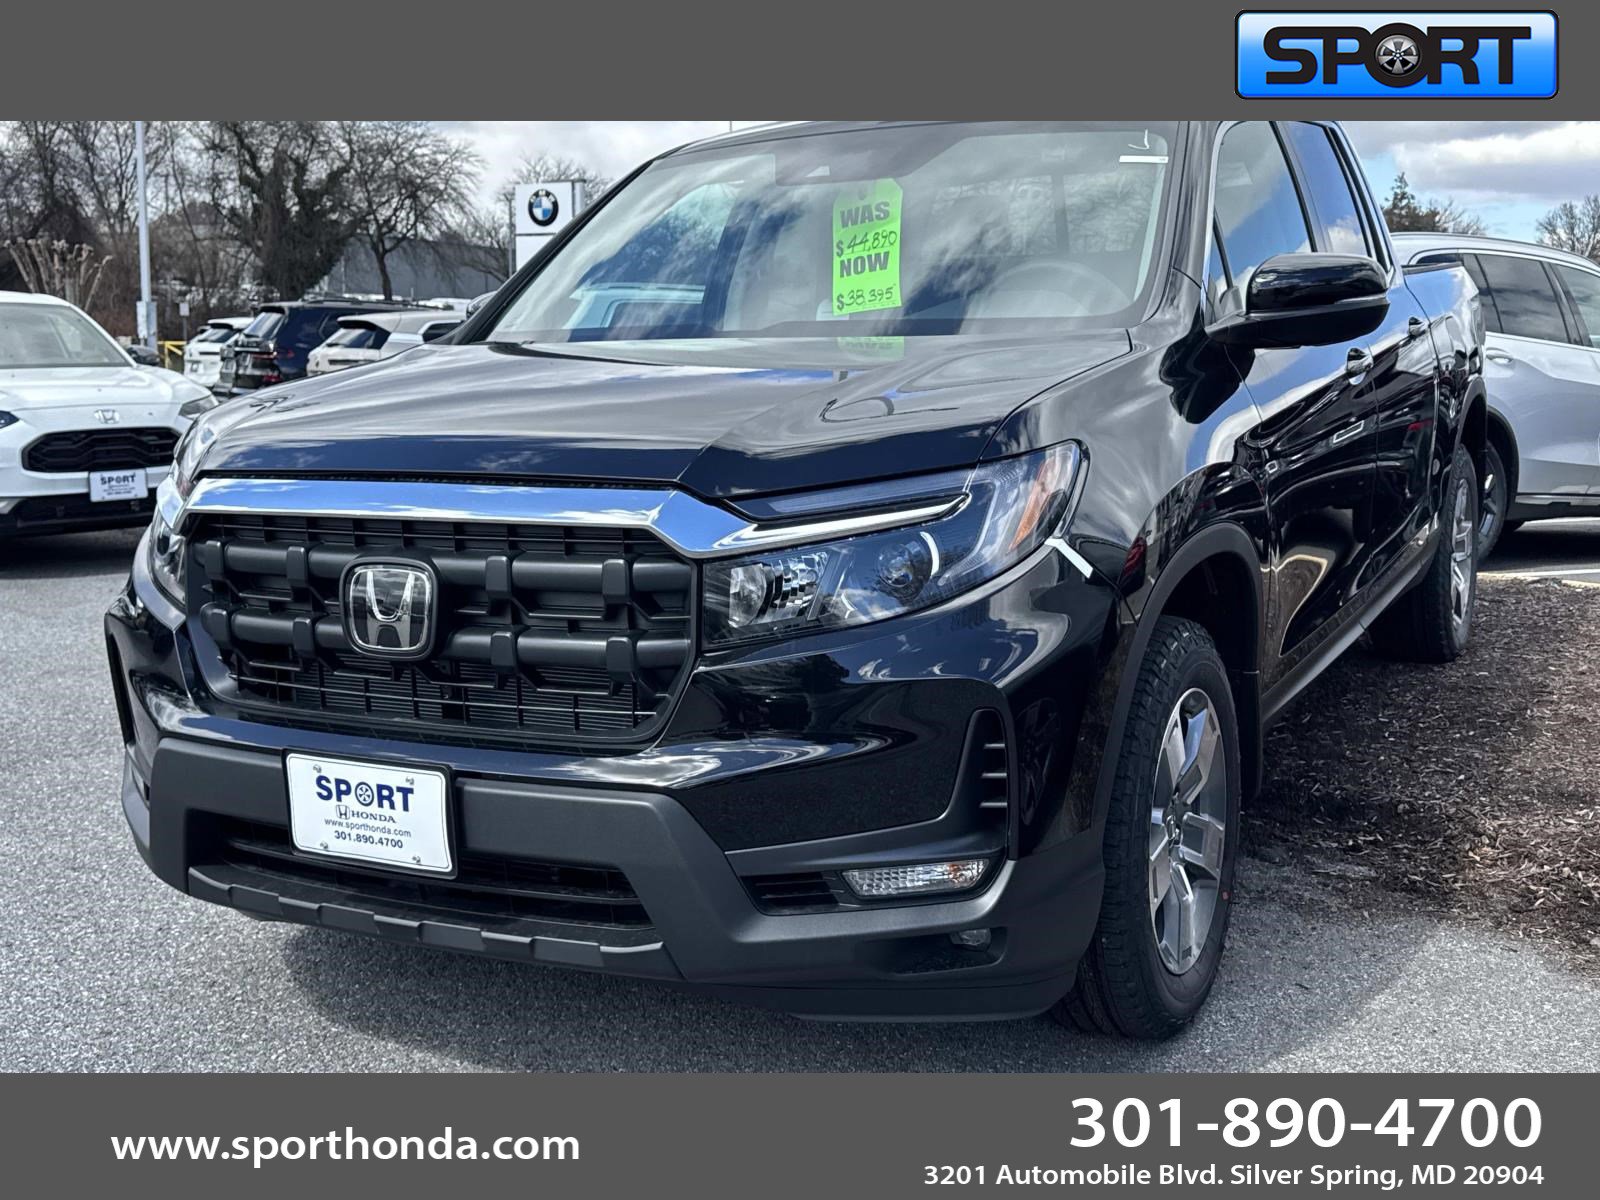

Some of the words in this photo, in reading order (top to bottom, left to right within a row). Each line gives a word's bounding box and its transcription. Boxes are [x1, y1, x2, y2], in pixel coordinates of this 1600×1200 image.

[840, 202, 890, 229] WAS
[840, 251, 890, 278] NOW
[101, 474, 135, 485] SPORT
[316, 775, 414, 812] SPORT
[324, 817, 411, 838] www.sporthonda.com
[351, 810, 397, 824] HONDA
[334, 831, 403, 849] 301.890.4700
